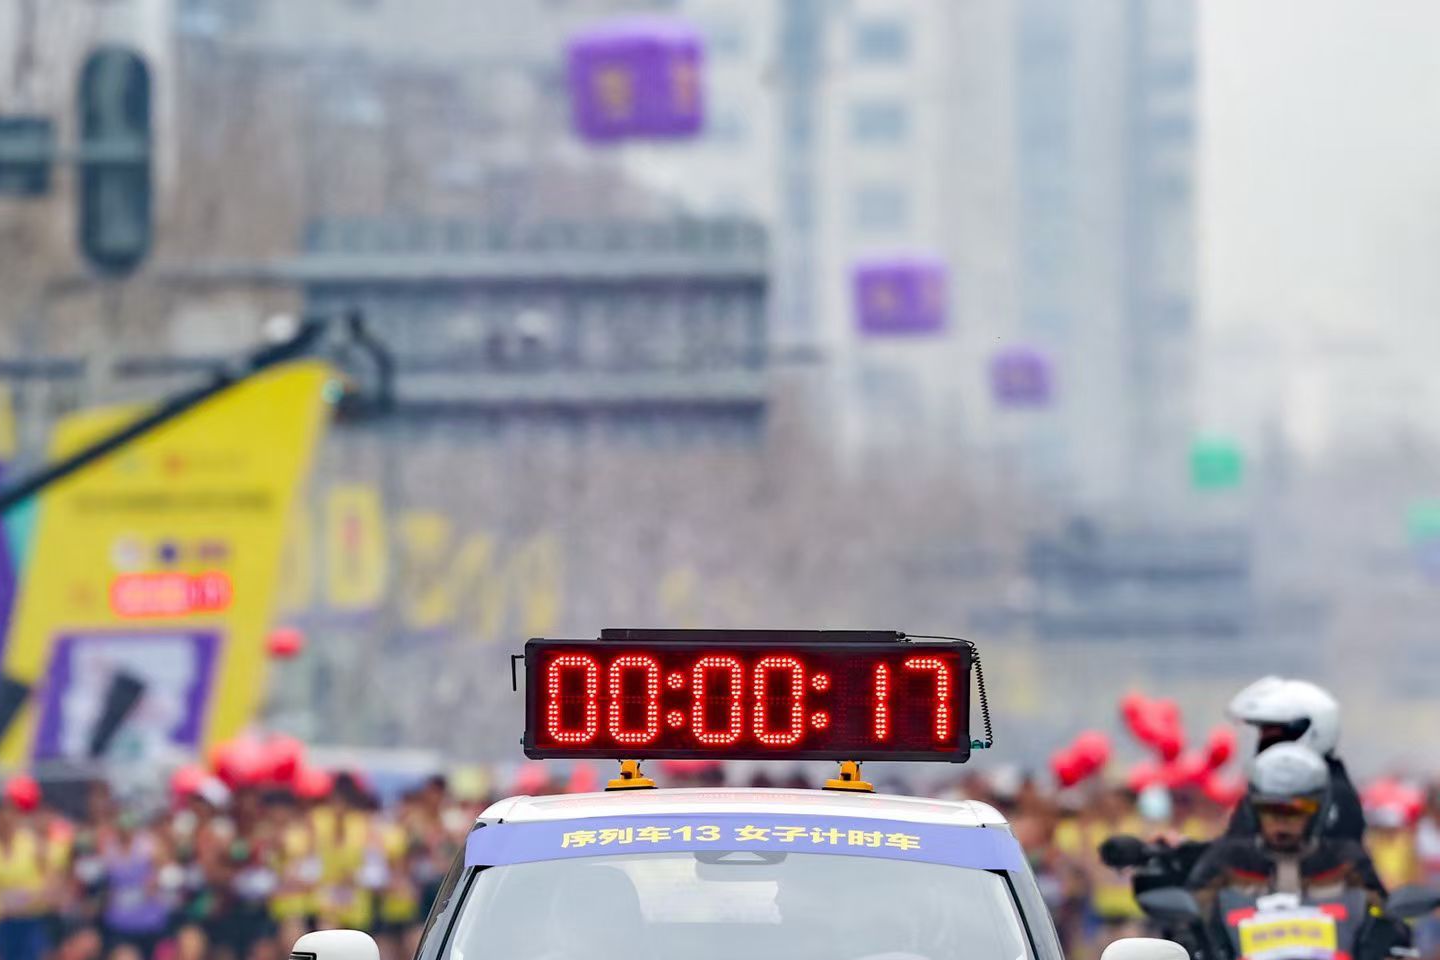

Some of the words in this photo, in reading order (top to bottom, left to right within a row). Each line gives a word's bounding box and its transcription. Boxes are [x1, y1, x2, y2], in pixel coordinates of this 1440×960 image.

[548, 656, 949, 744] 00:00:17
[561, 825, 721, 849] 序列车13
[734, 825, 921, 851] 女子计时车
